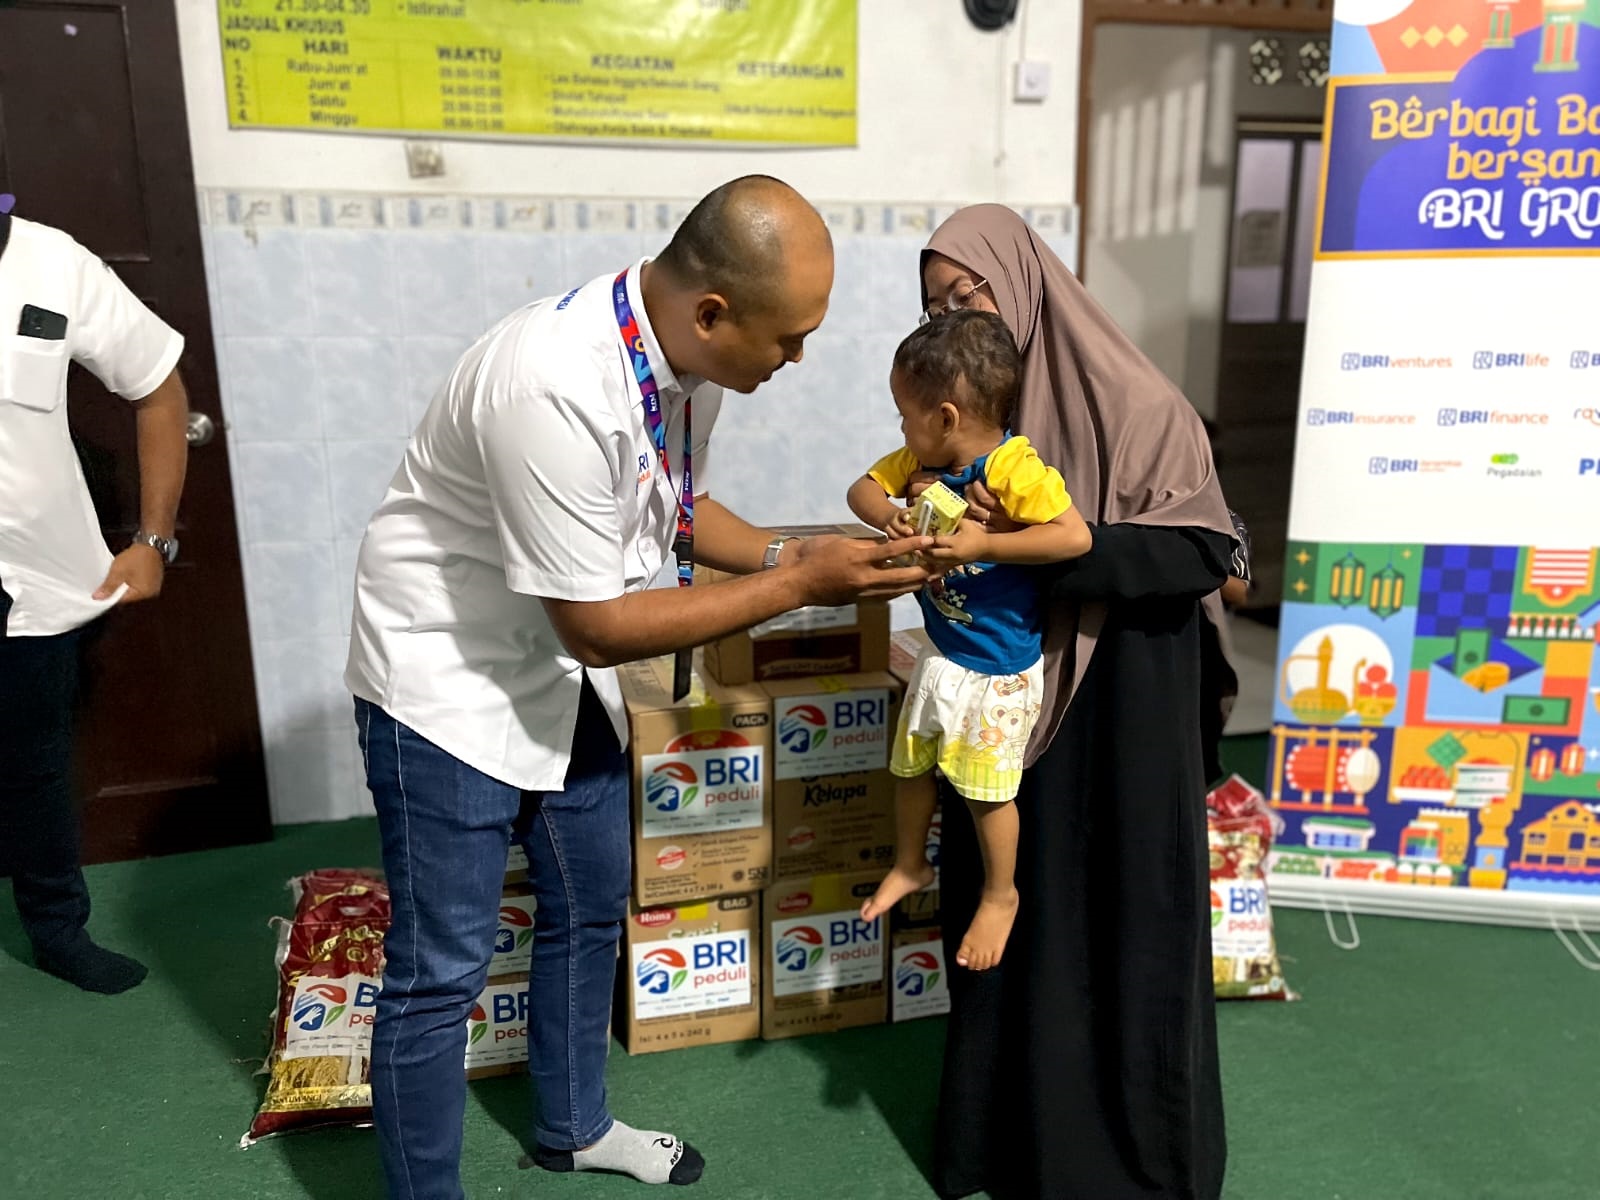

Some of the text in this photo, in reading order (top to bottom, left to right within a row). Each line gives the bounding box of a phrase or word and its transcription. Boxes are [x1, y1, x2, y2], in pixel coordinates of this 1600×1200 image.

[225, 17, 345, 34] JADUAL KHUSUS
[225, 38, 844, 79] NO HARI WAKTU KEGIATAN KETERANGAN
[311, 111, 358, 126] Minggu
[1419, 187, 1505, 239] BRI
[735, 715, 766, 726] PACK
[834, 700, 884, 728] BRI
[834, 727, 884, 748] peduli
[705, 755, 759, 787] BRI
[705, 786, 760, 807] peduli
[803, 784, 867, 807] Kelapa
[723, 898, 748, 909] BAG
[640, 911, 671, 923] Roma
[830, 917, 880, 947] BRI
[693, 938, 746, 969] BRI
[830, 944, 880, 964] peduli
[693, 966, 747, 988] peduli
